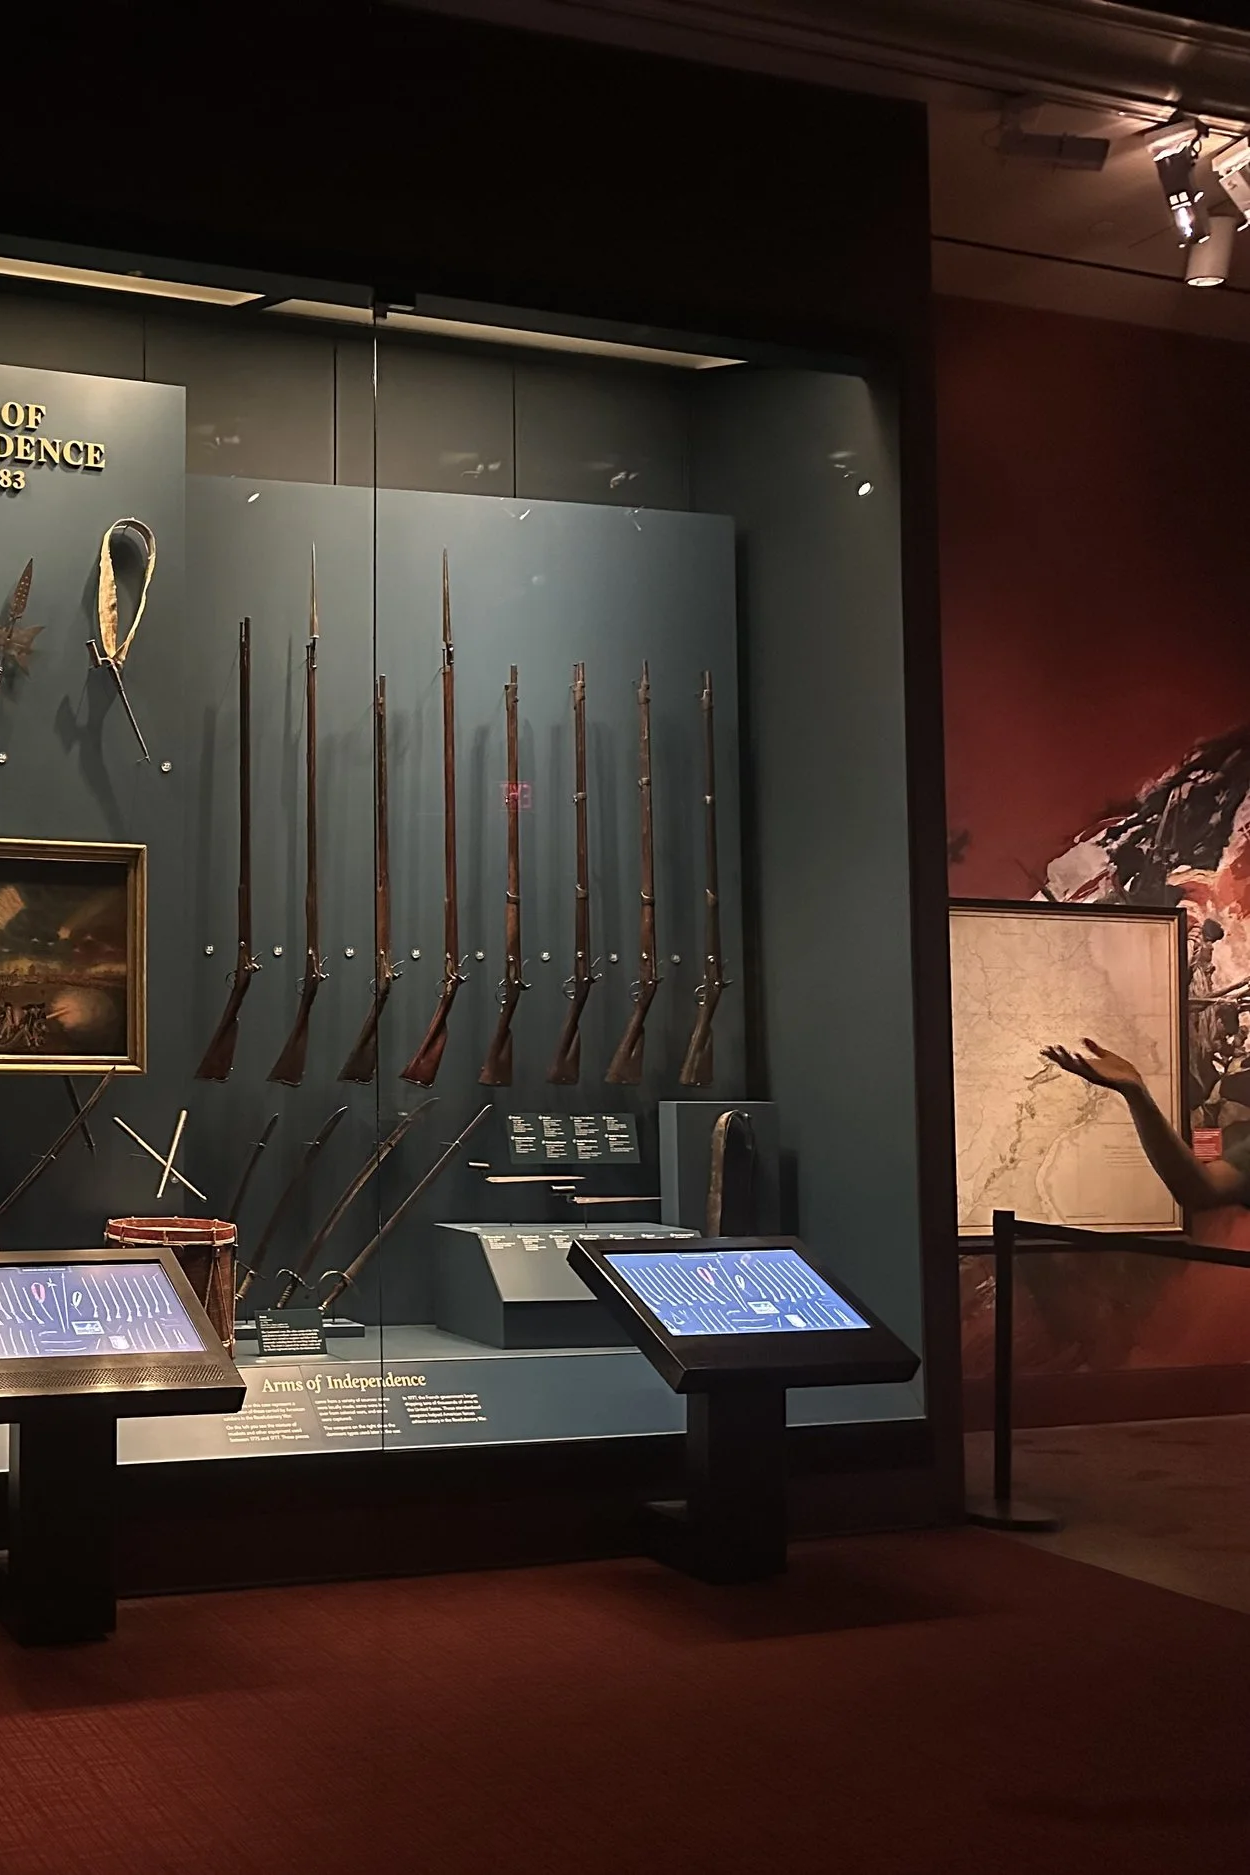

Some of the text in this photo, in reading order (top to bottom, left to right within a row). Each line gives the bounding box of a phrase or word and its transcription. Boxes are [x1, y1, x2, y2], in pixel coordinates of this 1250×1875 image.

[1, 401, 46, 429] OF
[262, 1371, 427, 1394] Arms of Independence
